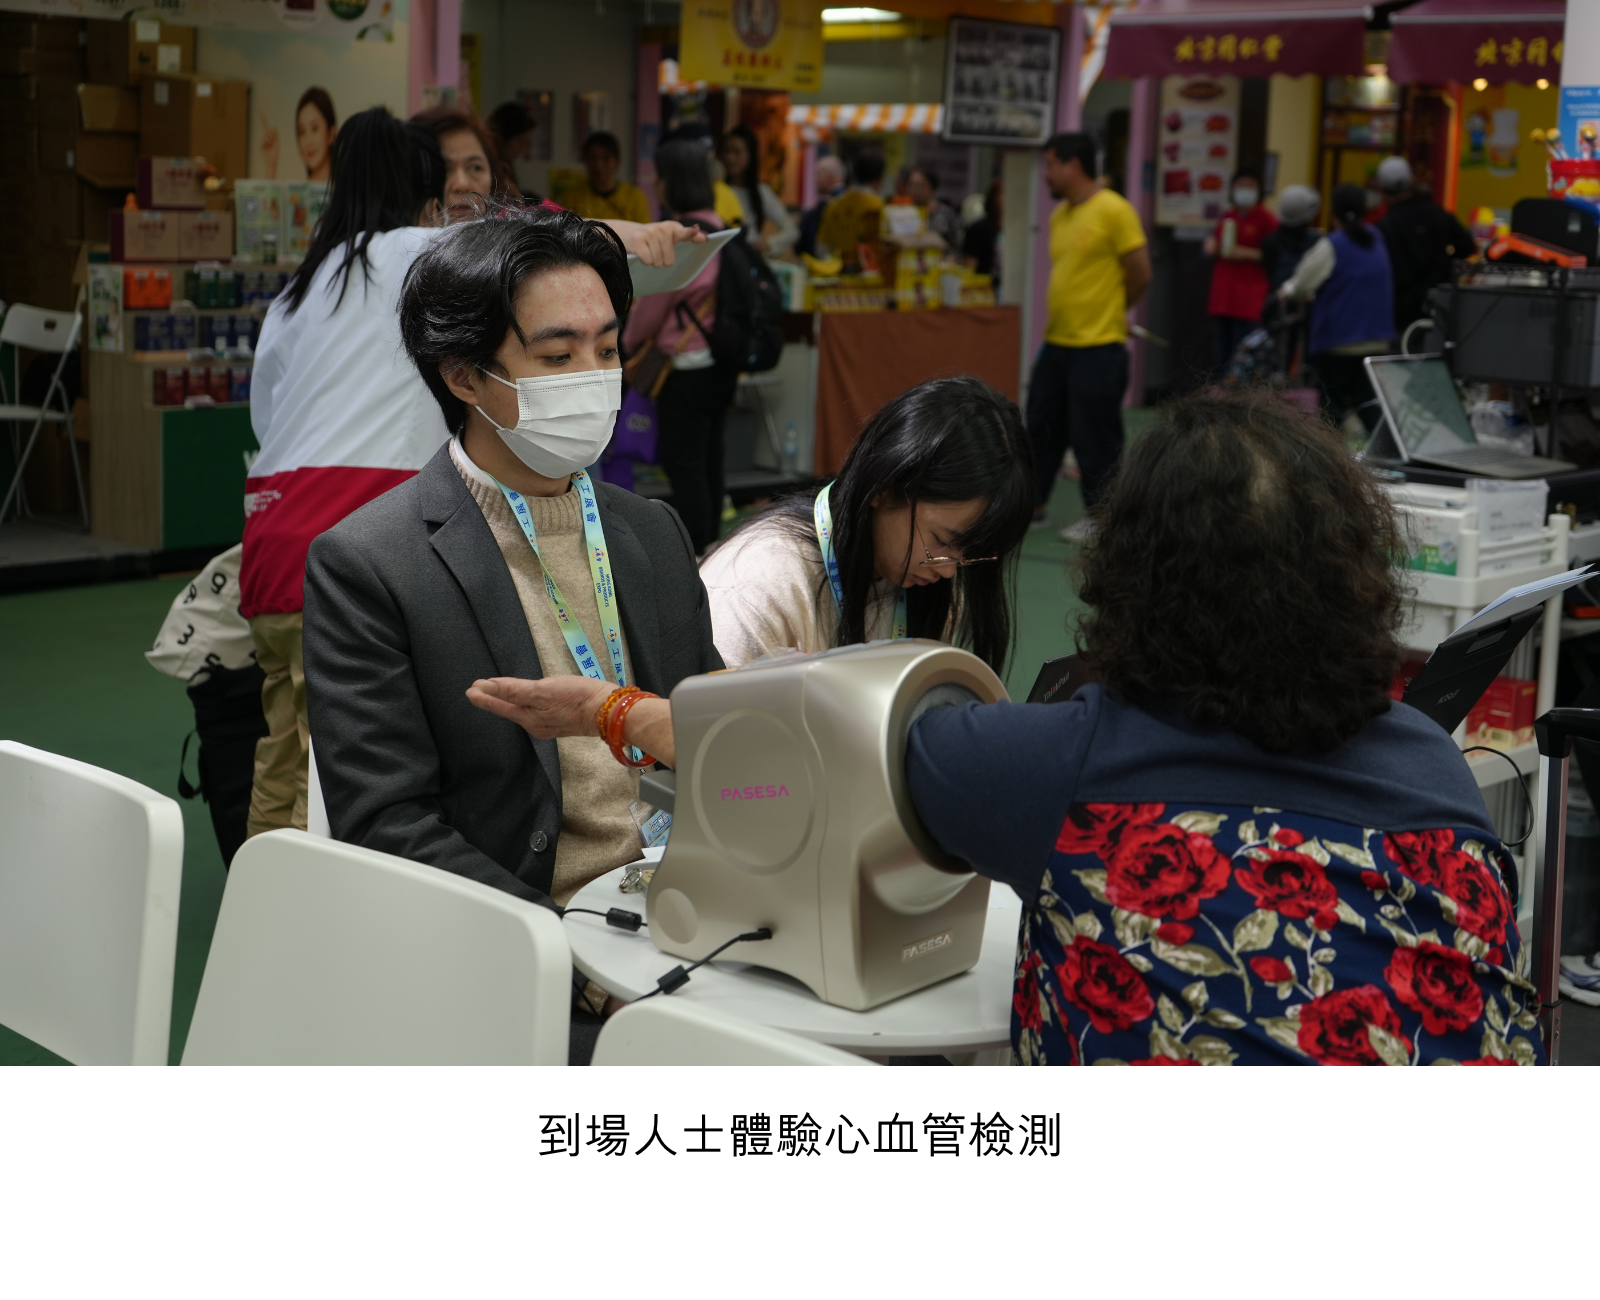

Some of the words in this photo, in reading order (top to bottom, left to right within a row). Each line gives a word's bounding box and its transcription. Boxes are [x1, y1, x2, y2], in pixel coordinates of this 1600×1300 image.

[1043, 671, 1070, 702] ThinkPad
[721, 784, 790, 801] PASESA
[902, 932, 952, 962] PASESA
